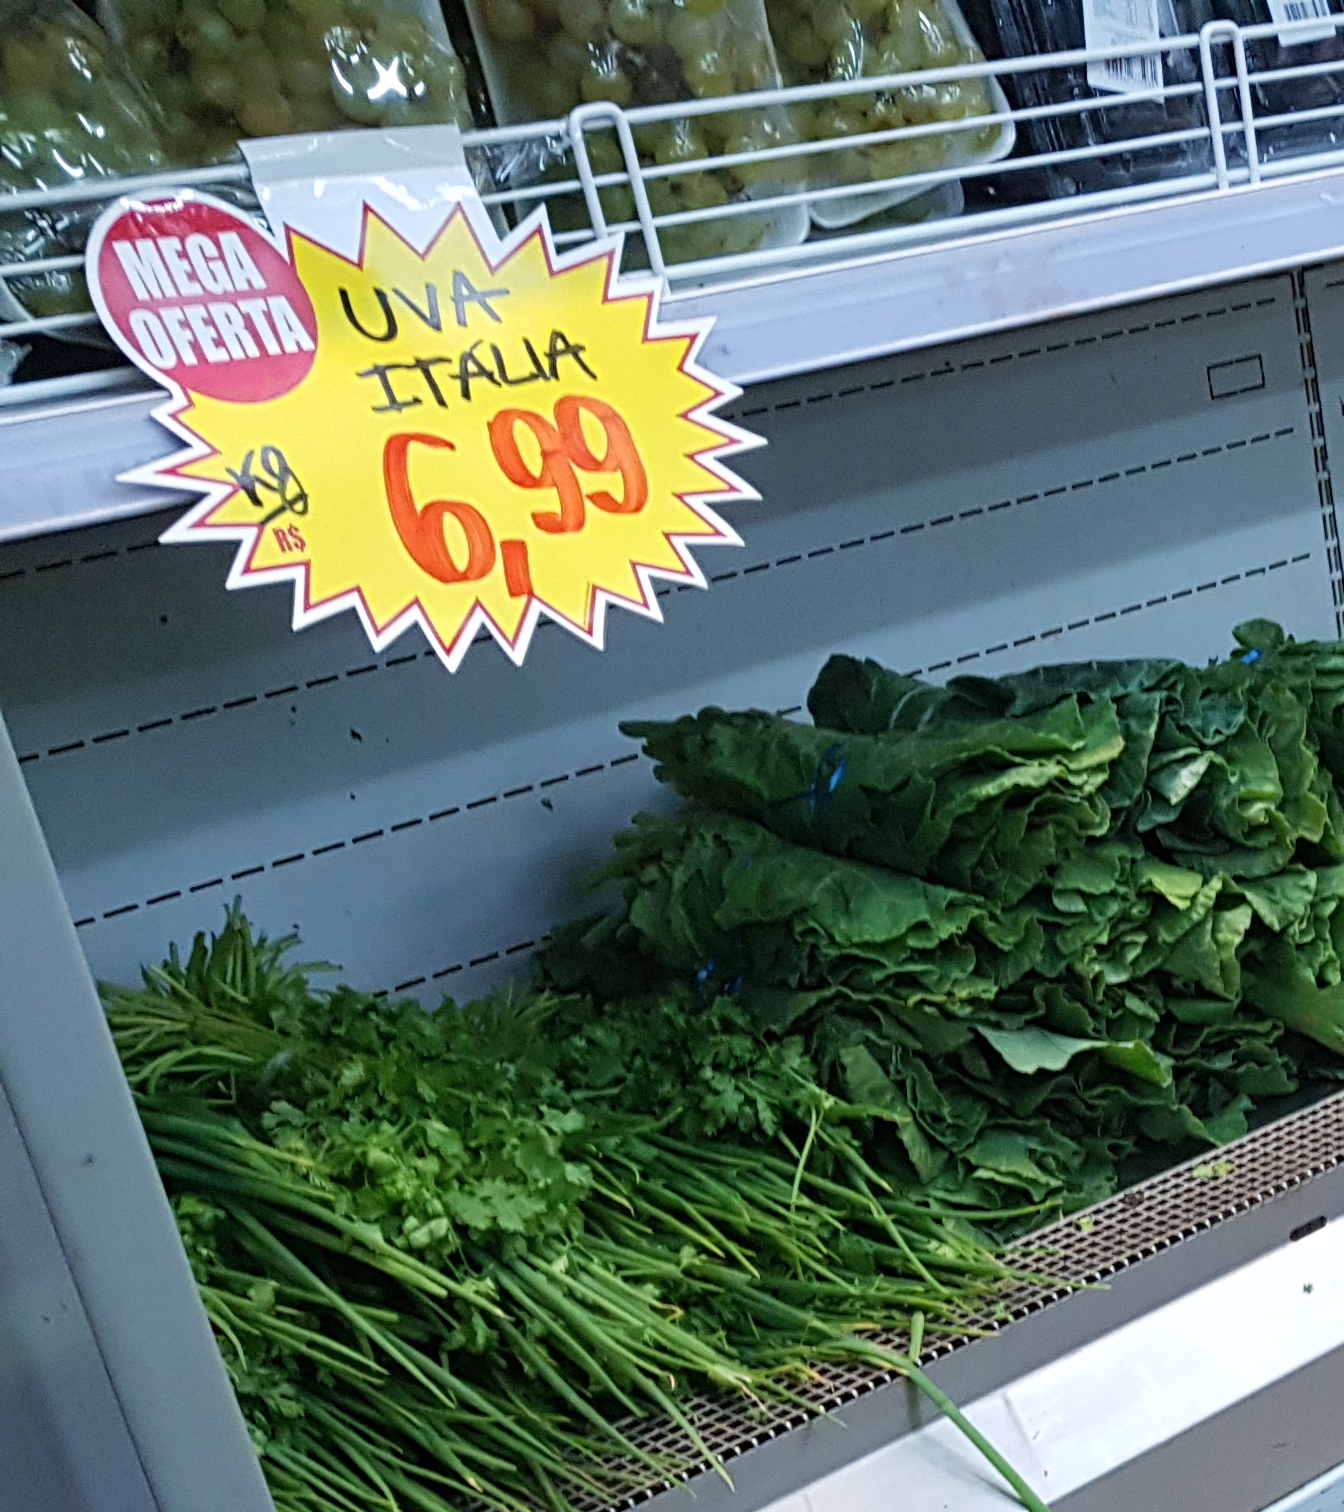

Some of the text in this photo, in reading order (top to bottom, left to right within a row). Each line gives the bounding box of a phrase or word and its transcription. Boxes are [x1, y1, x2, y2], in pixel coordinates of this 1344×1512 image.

[112, 231, 267, 302] MEGA
[129, 297, 315, 371] OFERTA
[339, 270, 510, 343] UVA
[382, 395, 650, 599] 6,99
[273, 523, 306, 554] R$
